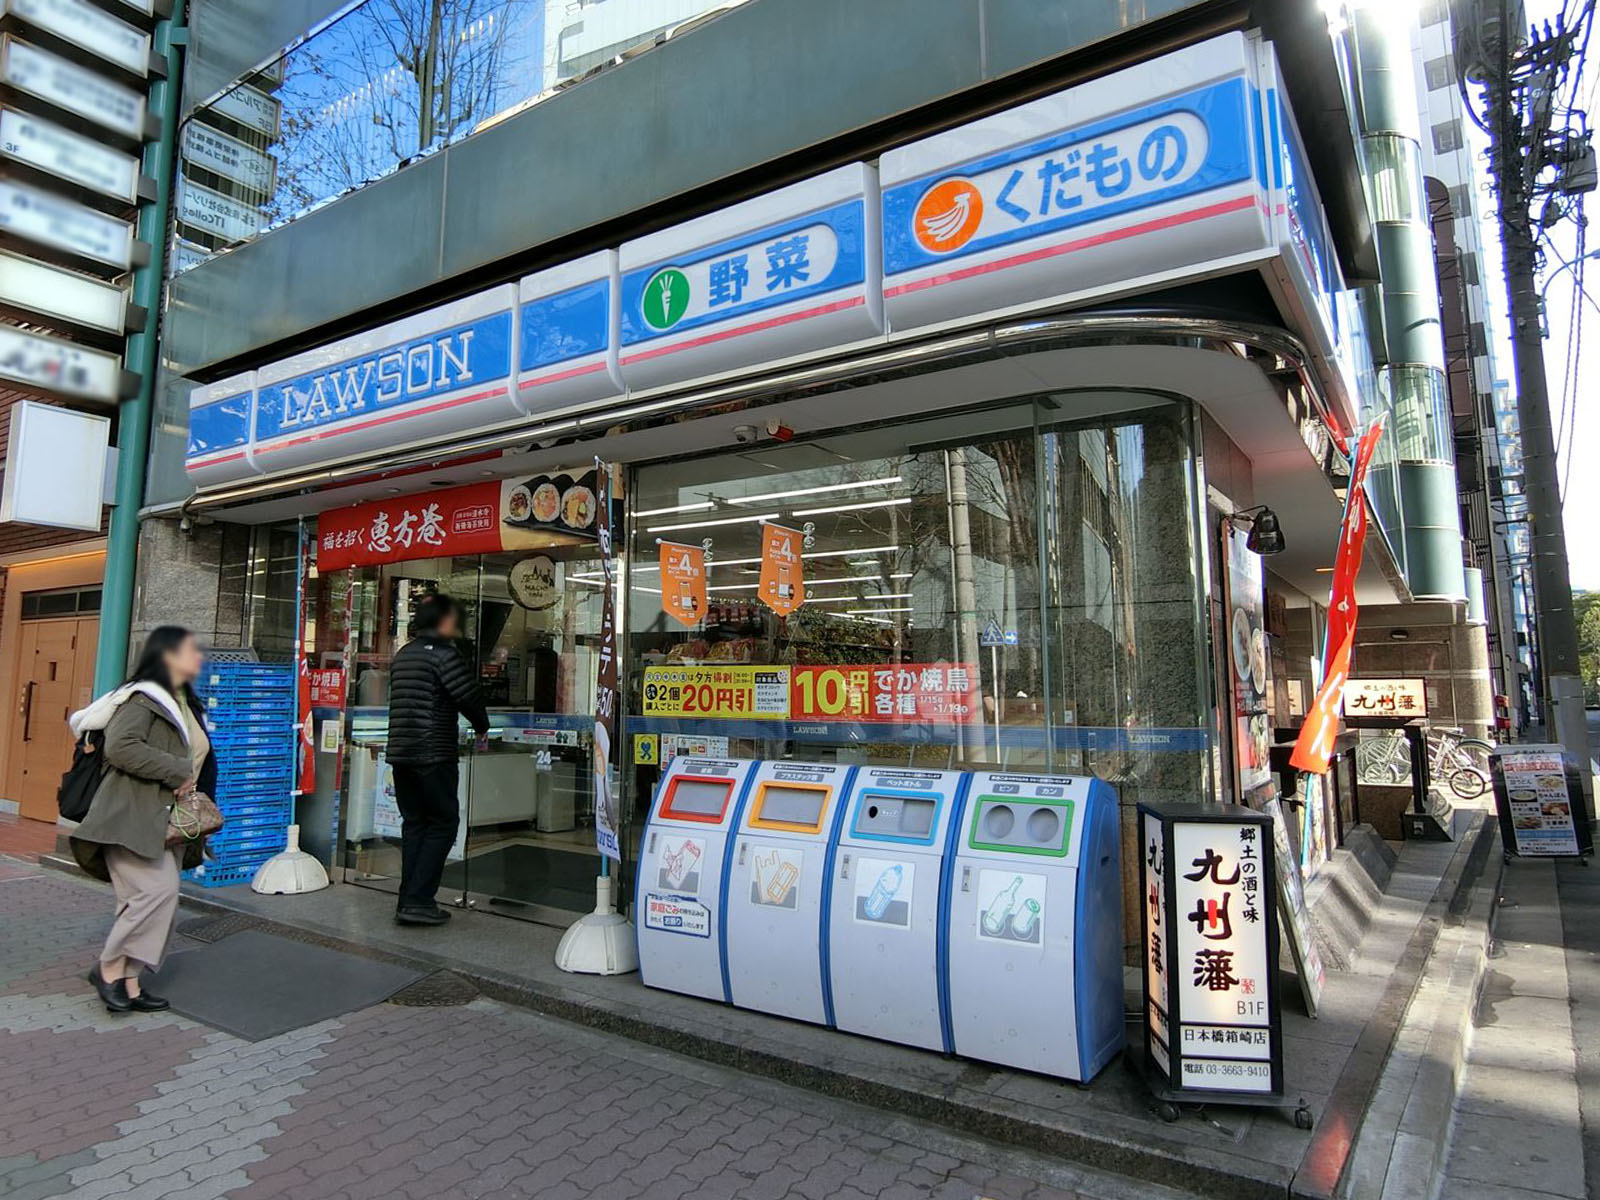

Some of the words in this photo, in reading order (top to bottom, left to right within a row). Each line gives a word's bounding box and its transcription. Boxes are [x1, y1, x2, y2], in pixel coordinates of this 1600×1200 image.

[6, 143, 19, 153] 3F
[996, 124, 1187, 223] くだもの
[708, 235, 811, 307] 野菜
[278, 330, 477, 429] LAWSON
[322, 527, 365, 551] 福を招く
[367, 503, 446, 553] 恵方巻
[874, 668, 969, 692] でか焼鳥
[682, 684, 752, 712] 20円引
[875, 693, 917, 715] 各種
[1351, 692, 1417, 711] 九州藩
[536, 750, 552, 765] 24
[1239, 827, 1259, 923] 郷土の酒と味
[1183, 849, 1241, 992] 九州藩
[1237, 1001, 1265, 1016] B1F
[1184, 1029, 1266, 1045] 日本橋箱崎店
[1184, 1063, 1204, 1074] 電話
[1206, 1065, 1269, 1077] 03-3663-9410
